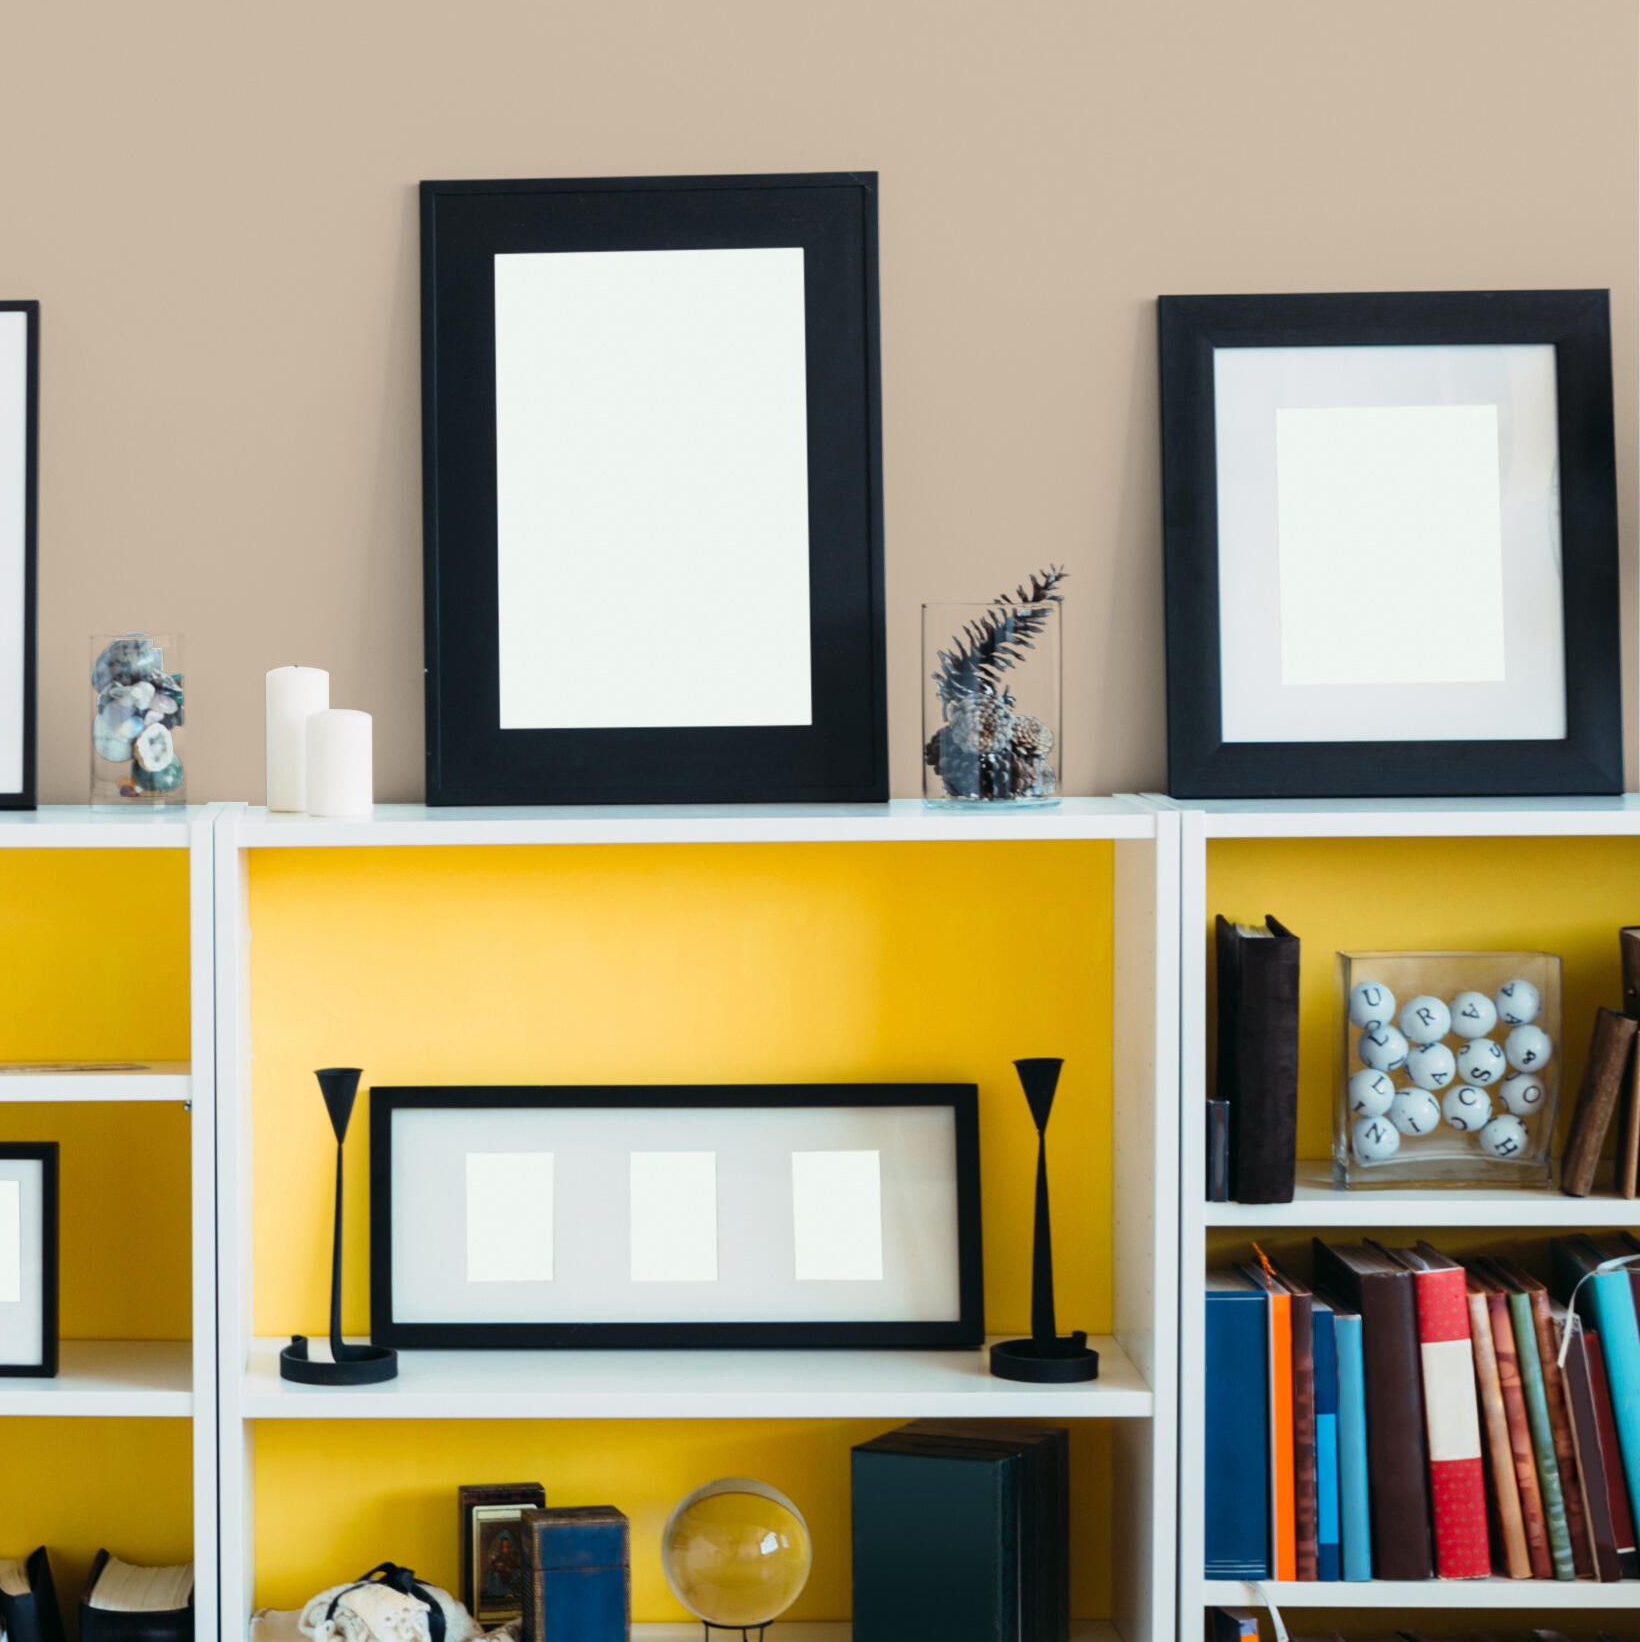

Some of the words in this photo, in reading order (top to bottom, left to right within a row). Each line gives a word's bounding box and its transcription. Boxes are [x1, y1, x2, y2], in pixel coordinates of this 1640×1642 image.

[1362, 986, 1382, 1007] U
[1416, 1007, 1437, 1027] R
[1461, 1002, 1480, 1019] A
[1470, 1066, 1492, 1082] S
[1371, 1075, 1385, 1095] L
[1522, 1085, 1541, 1104] O
[1458, 1087, 1477, 1106] C
[1494, 1137, 1518, 1156] H
